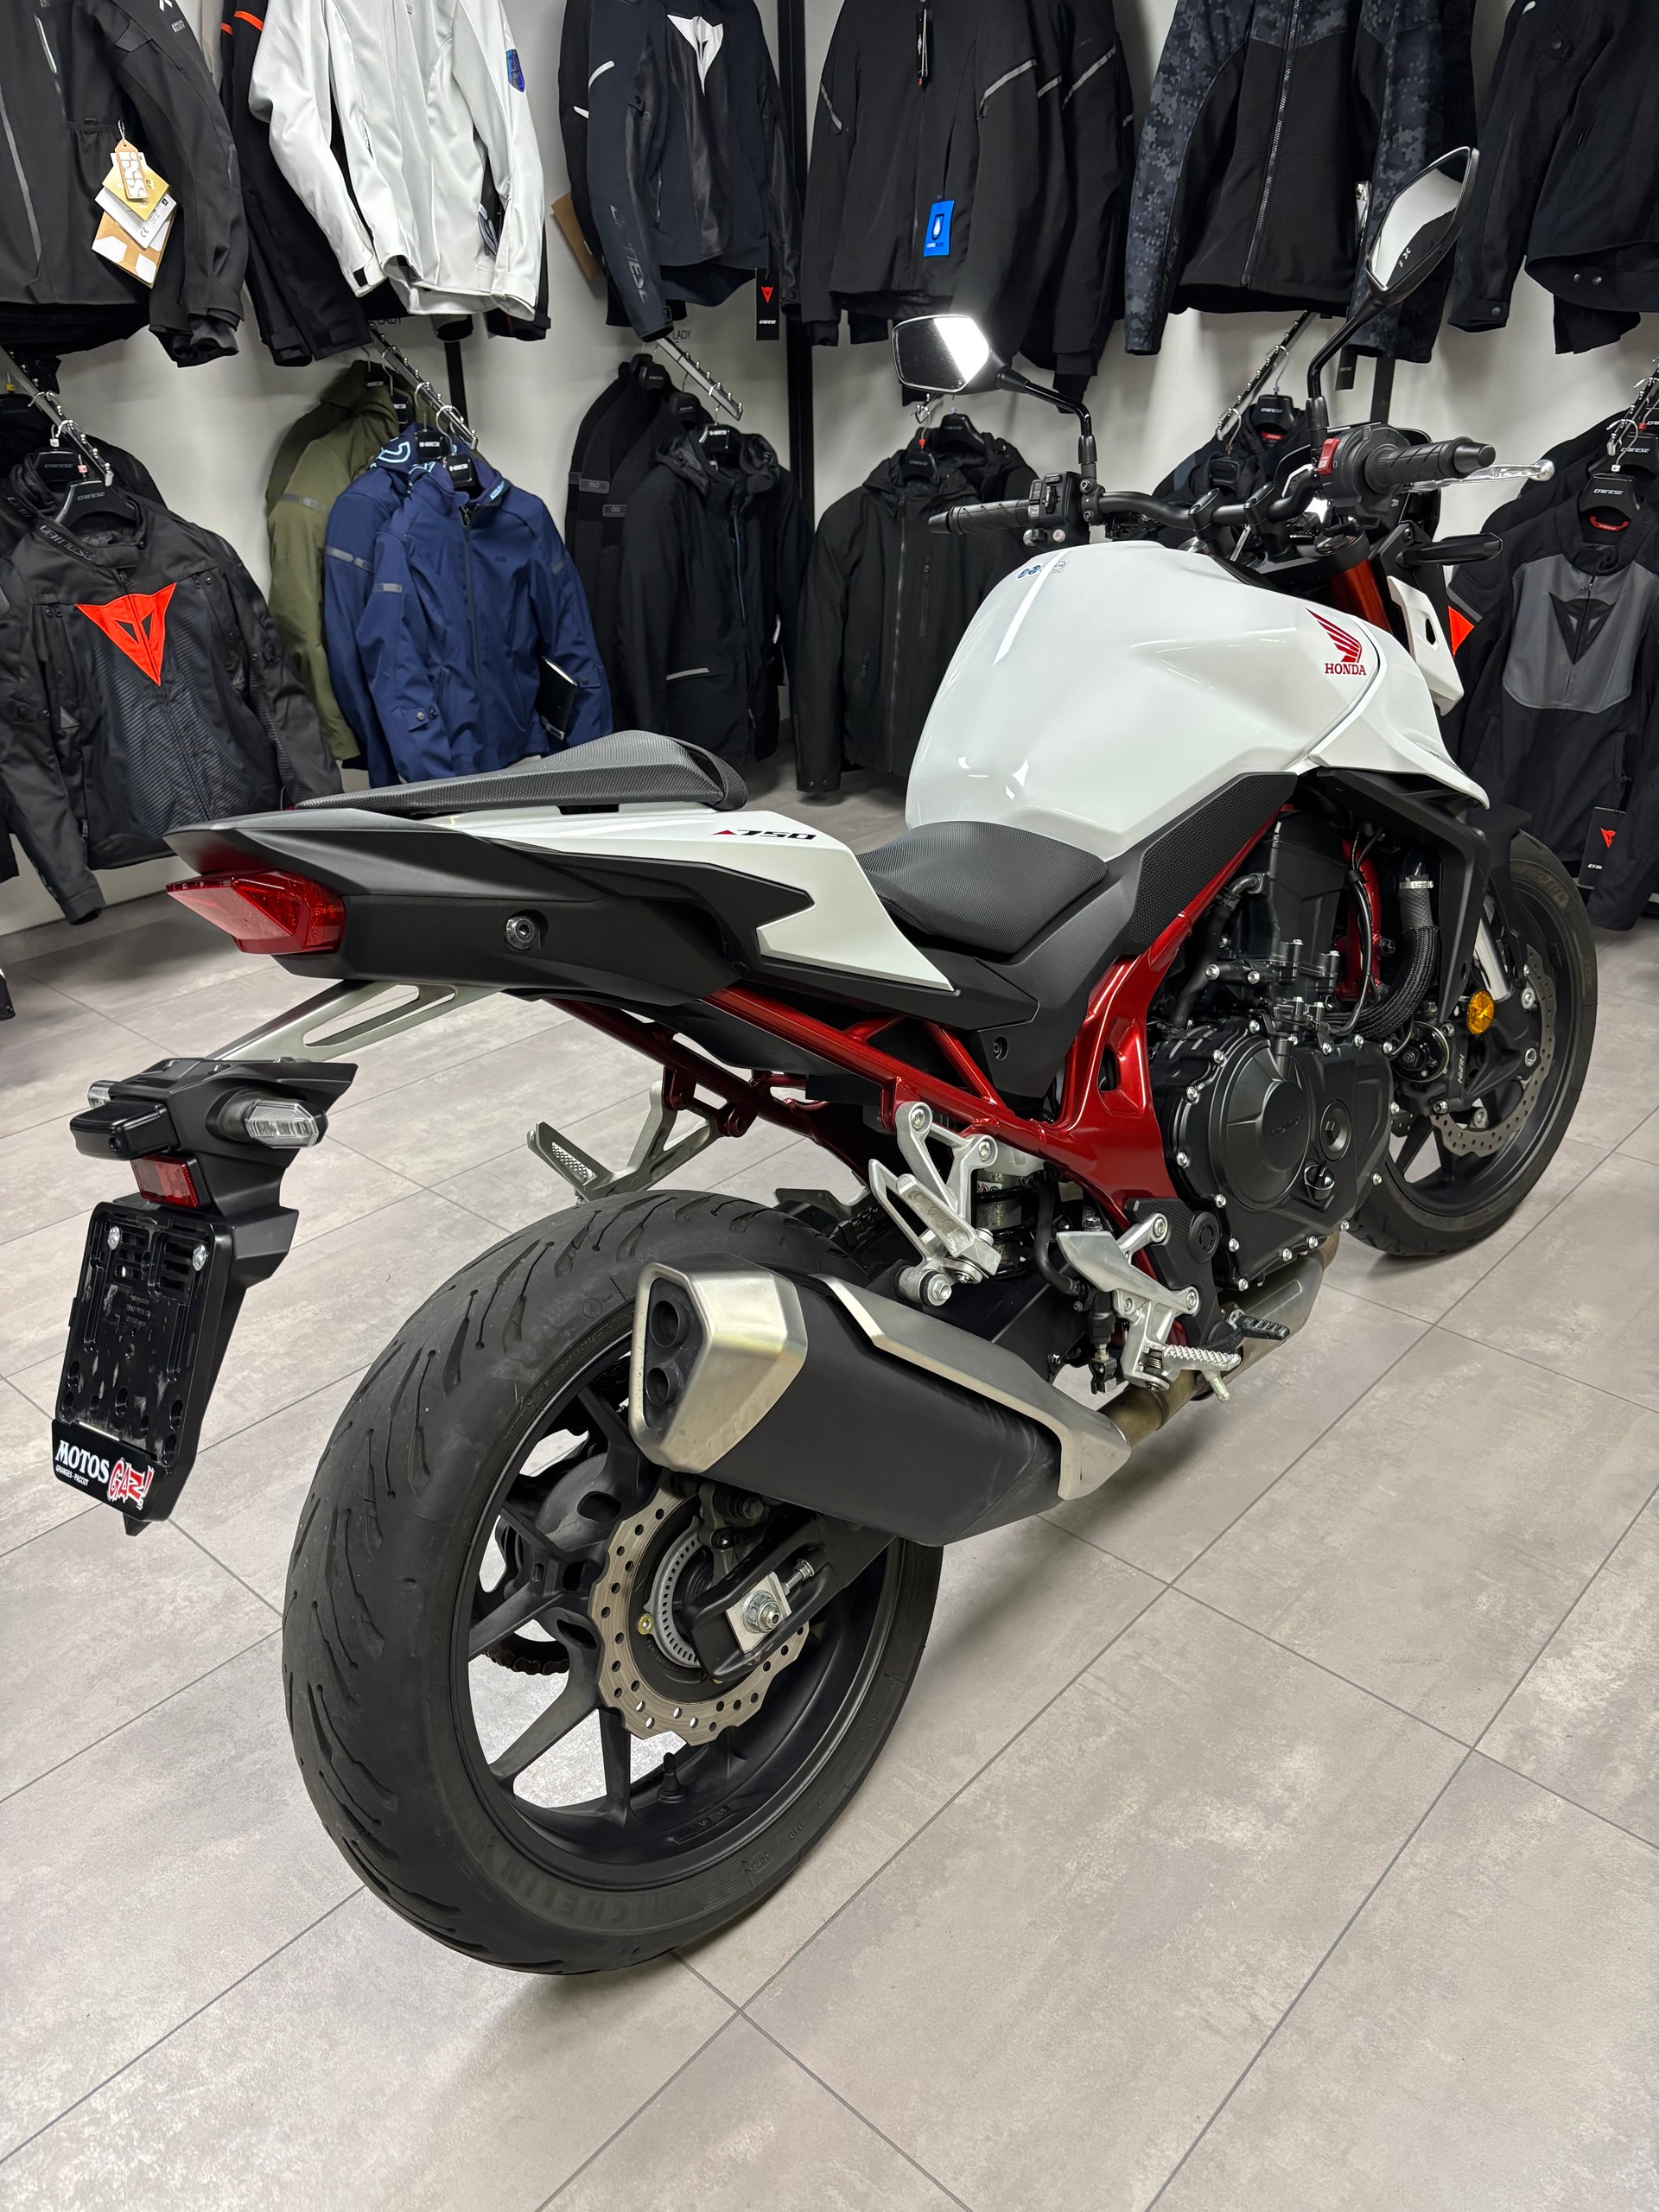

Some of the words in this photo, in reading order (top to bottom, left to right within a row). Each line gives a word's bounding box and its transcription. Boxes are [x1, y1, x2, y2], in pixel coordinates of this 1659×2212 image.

[673, 330, 691, 340] LADY
[40, 524, 96, 562] DAINESE
[1324, 663, 1367, 676] HONDA
[736, 830, 817, 841] 750
[54, 1440, 110, 1484] MOTOS
